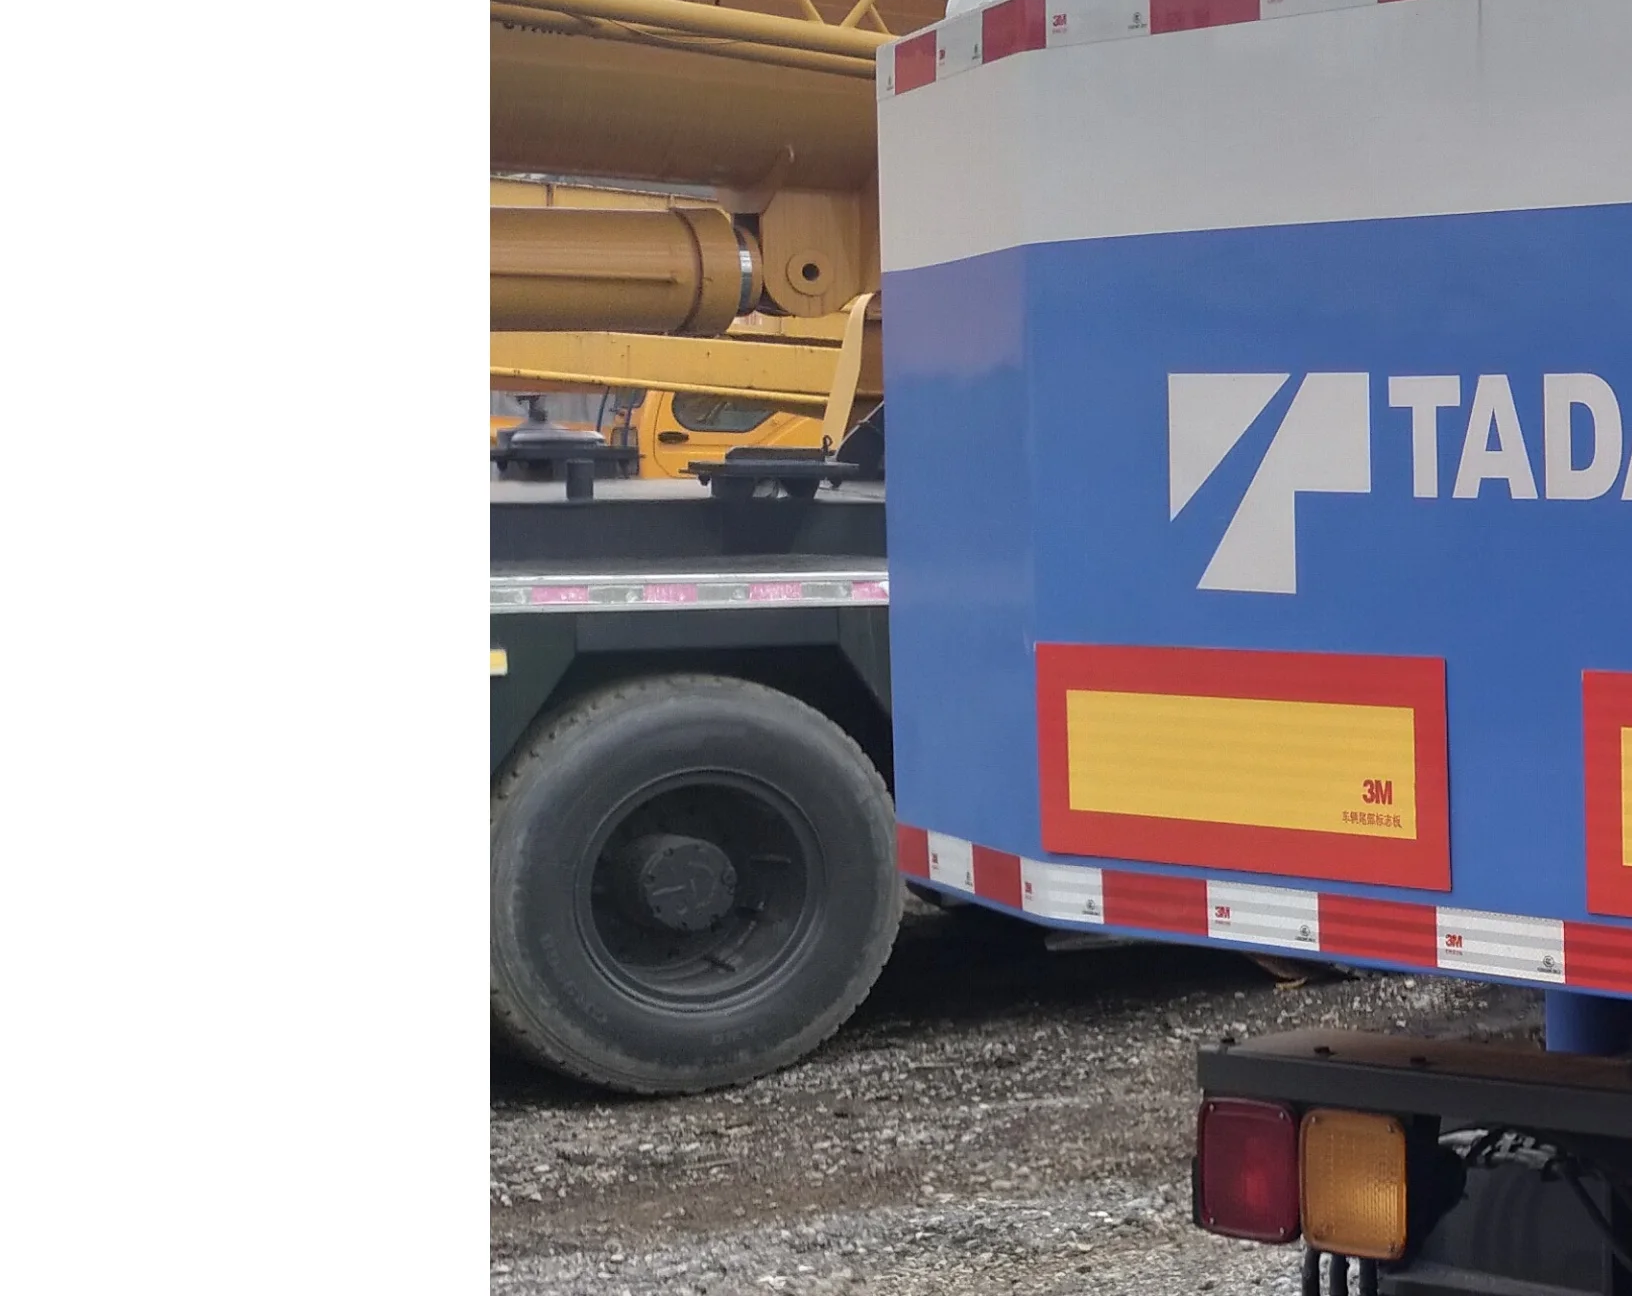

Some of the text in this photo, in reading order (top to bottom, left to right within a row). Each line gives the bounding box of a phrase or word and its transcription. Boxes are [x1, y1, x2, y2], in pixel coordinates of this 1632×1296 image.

[1052, 13, 1067, 27] 3M
[1362, 779, 1393, 805] 3M
[1214, 905, 1231, 919] 3M
[1445, 934, 1463, 947] 3M
